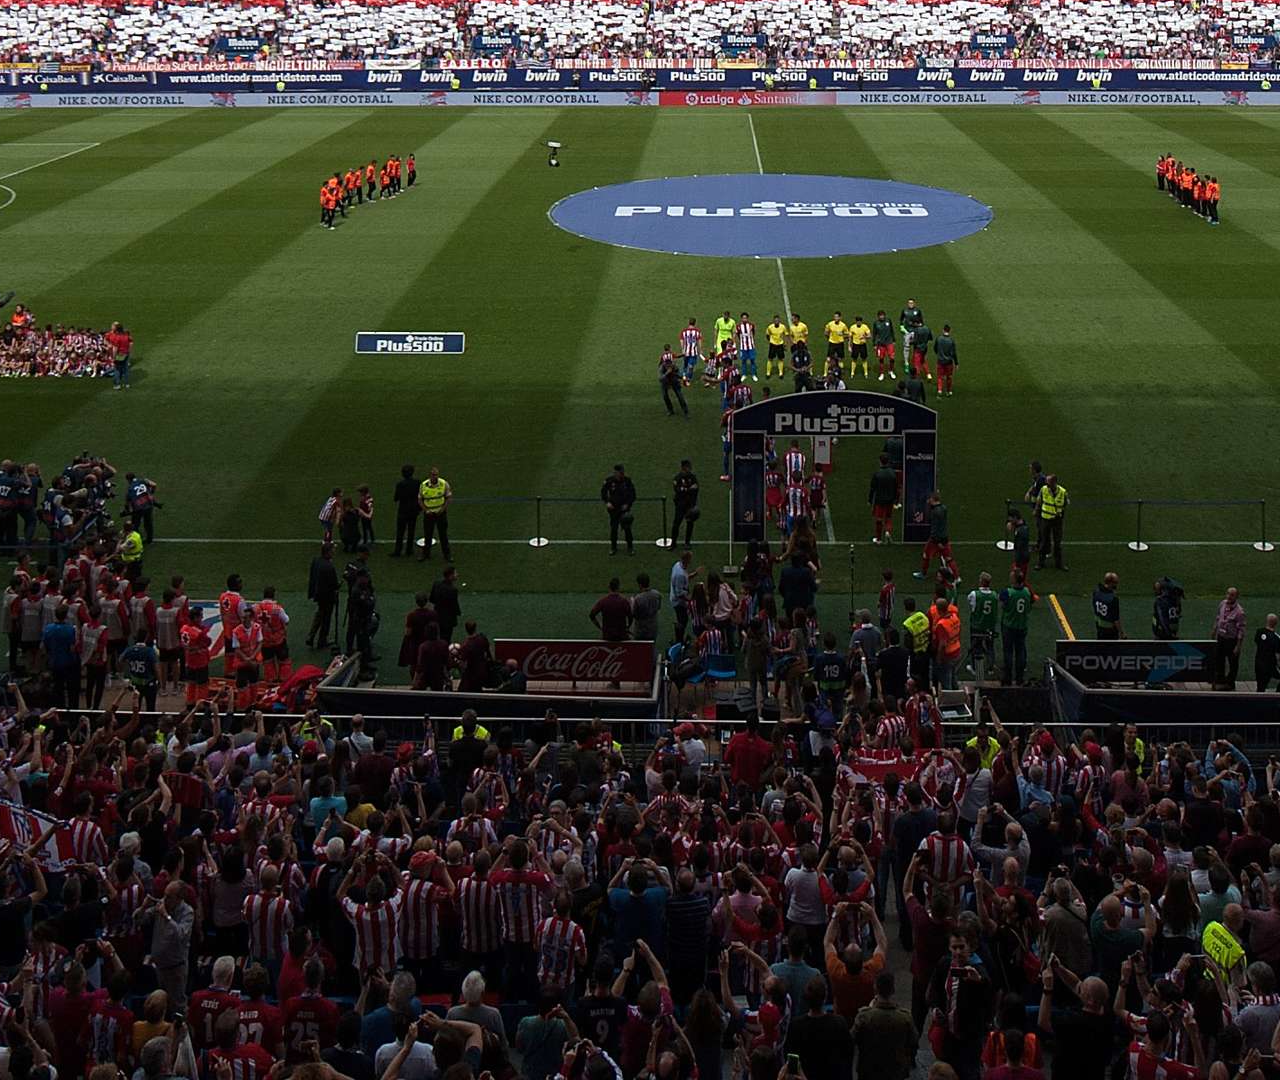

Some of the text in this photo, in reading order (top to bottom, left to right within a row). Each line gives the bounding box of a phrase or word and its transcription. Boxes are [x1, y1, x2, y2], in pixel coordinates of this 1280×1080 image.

[788, 59, 904, 68] SANTA ANA DE PUSA
[35, 75, 77, 83] CaixaBank
[105, 74, 148, 83] CaixaBank
[367, 70, 403, 83] bwin
[473, 70, 508, 82] bwin
[525, 69, 560, 82] bwin
[670, 72, 726, 81] Plus500
[917, 69, 952, 81] bwin
[970, 69, 1005, 81] bwin
[1023, 69, 1058, 81] bwin
[59, 96, 185, 105] NIKE.COM/FOOTBALL
[268, 95, 393, 105] NIKE.COM/FOOTBALL
[473, 94, 599, 104] NIKE.COM/FOOTBALL
[700, 95, 734, 105] LaLiga
[860, 94, 986, 103] NIKE.COM/FOOTBALL
[1068, 93, 1196, 103] NIKE.COM/FOOTBALL
[614, 206, 929, 217] Plus500
[376, 340, 444, 352] Plus500
[843, 406, 895, 414] Trade Online
[775, 414, 895, 432] Plus500
[983, 600, 992, 614] 5
[1016, 598, 1025, 614] 6
[1066, 655, 1203, 670] POWERADE
